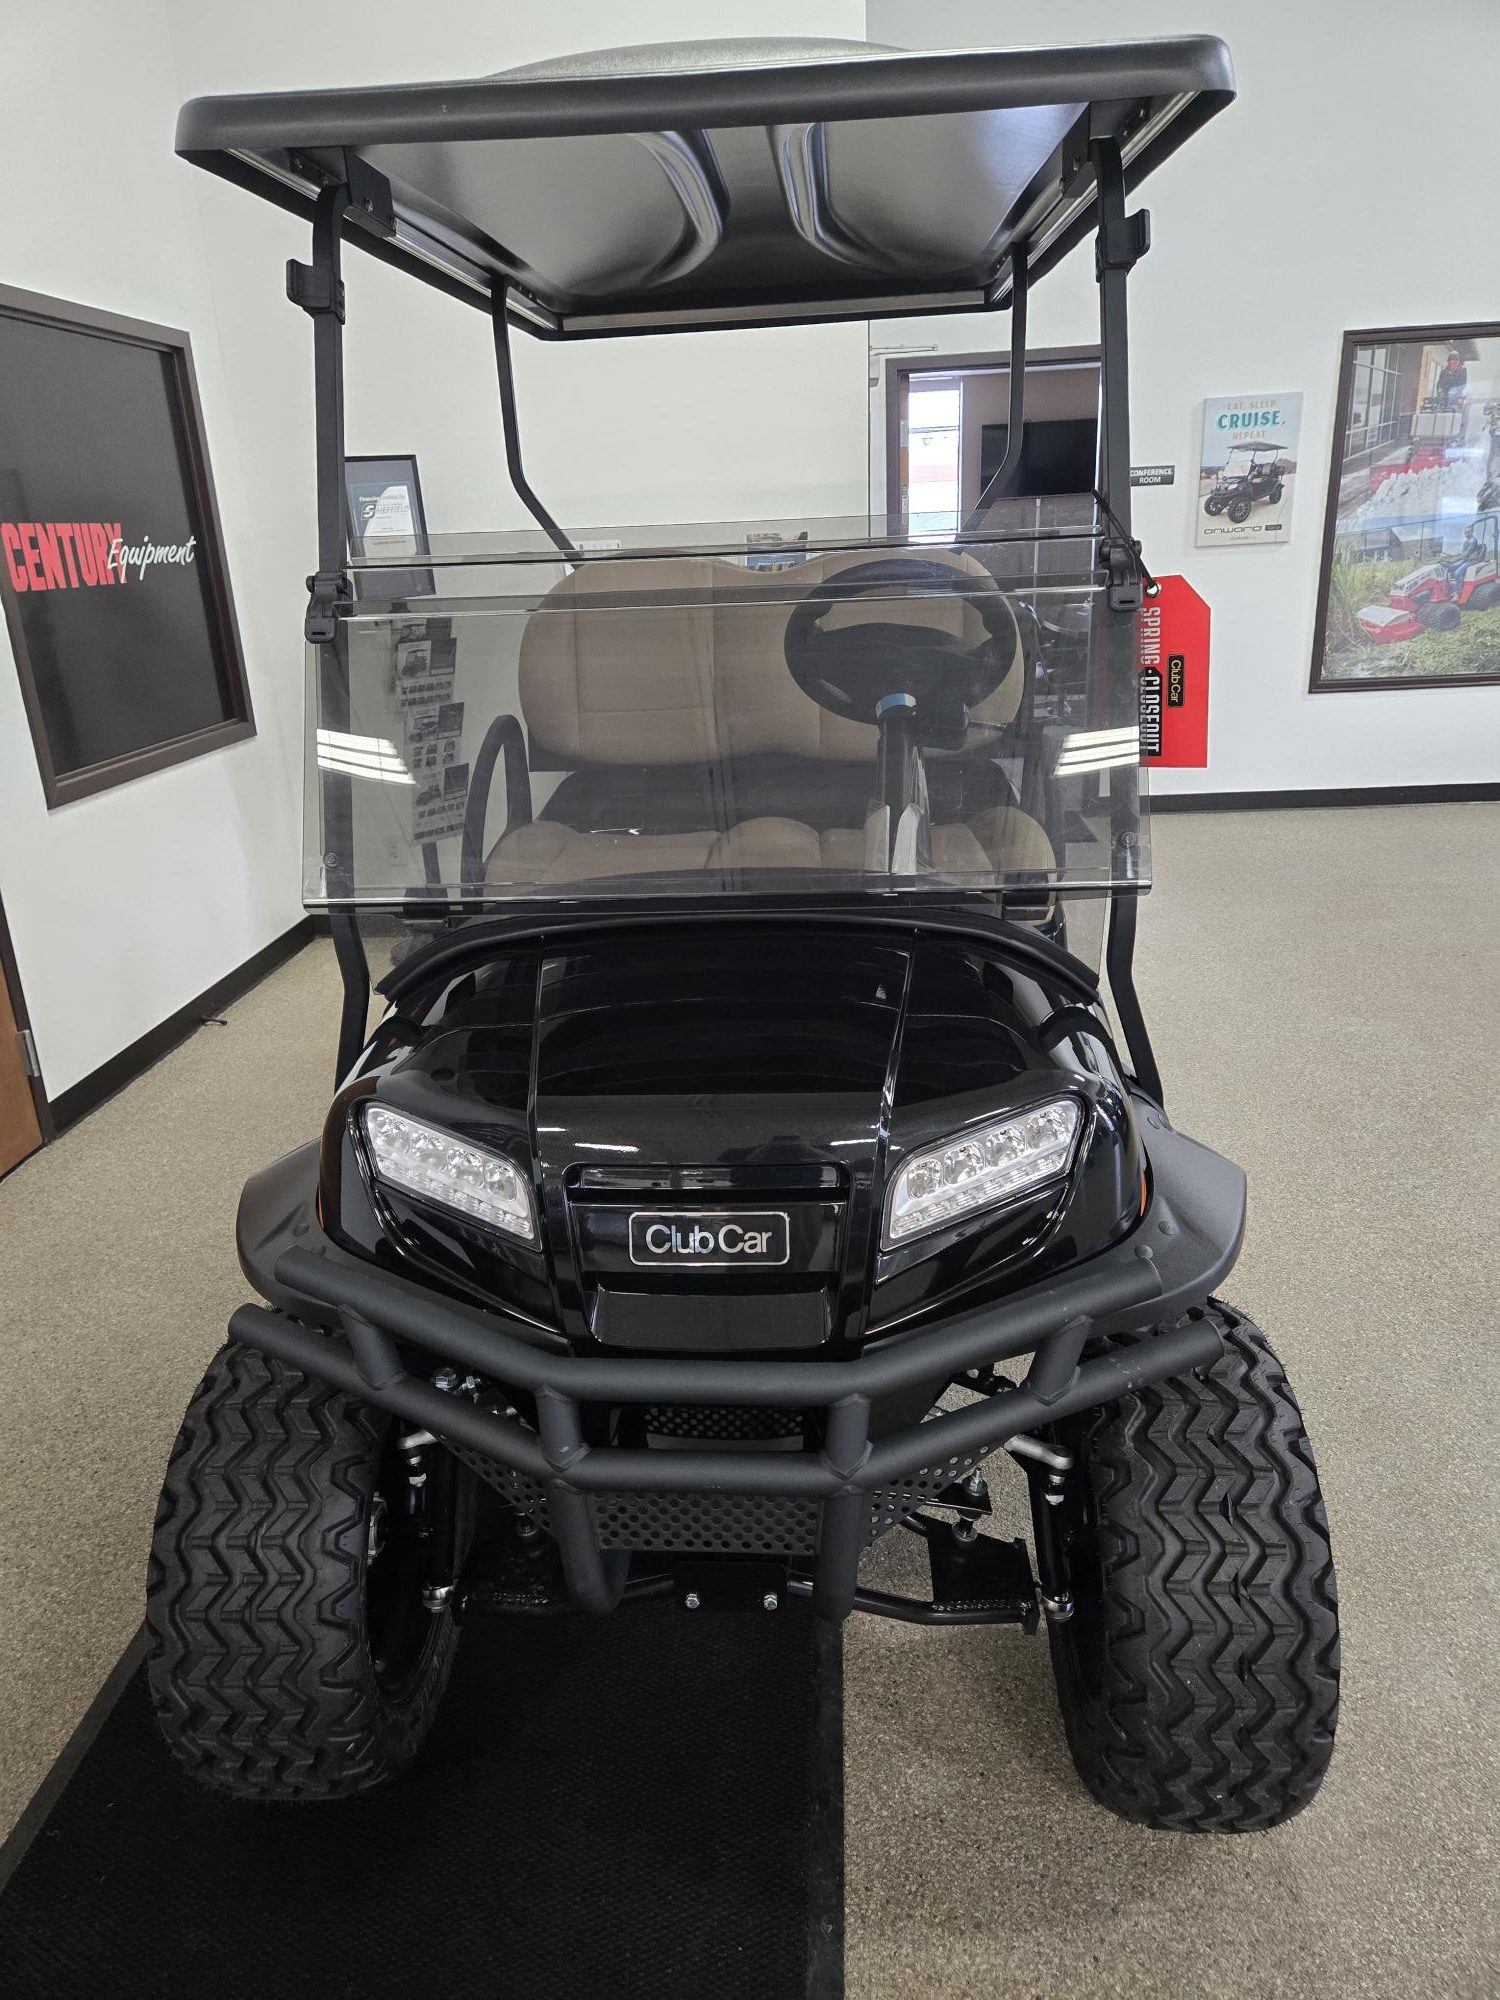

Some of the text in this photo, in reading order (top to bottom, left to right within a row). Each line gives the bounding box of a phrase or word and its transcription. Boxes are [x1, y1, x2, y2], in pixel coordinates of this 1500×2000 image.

[1217, 410, 1286, 429] CRUISE.
[1130, 468, 1172, 476] CONFERENCE
[0, 523, 127, 592] CENTURY
[107, 535, 197, 584] Equipment
[1140, 606, 1161, 753] SPRING CLOSEOUT
[1170, 659, 1182, 703] Club Car
[645, 1224, 772, 1254] Club Car
